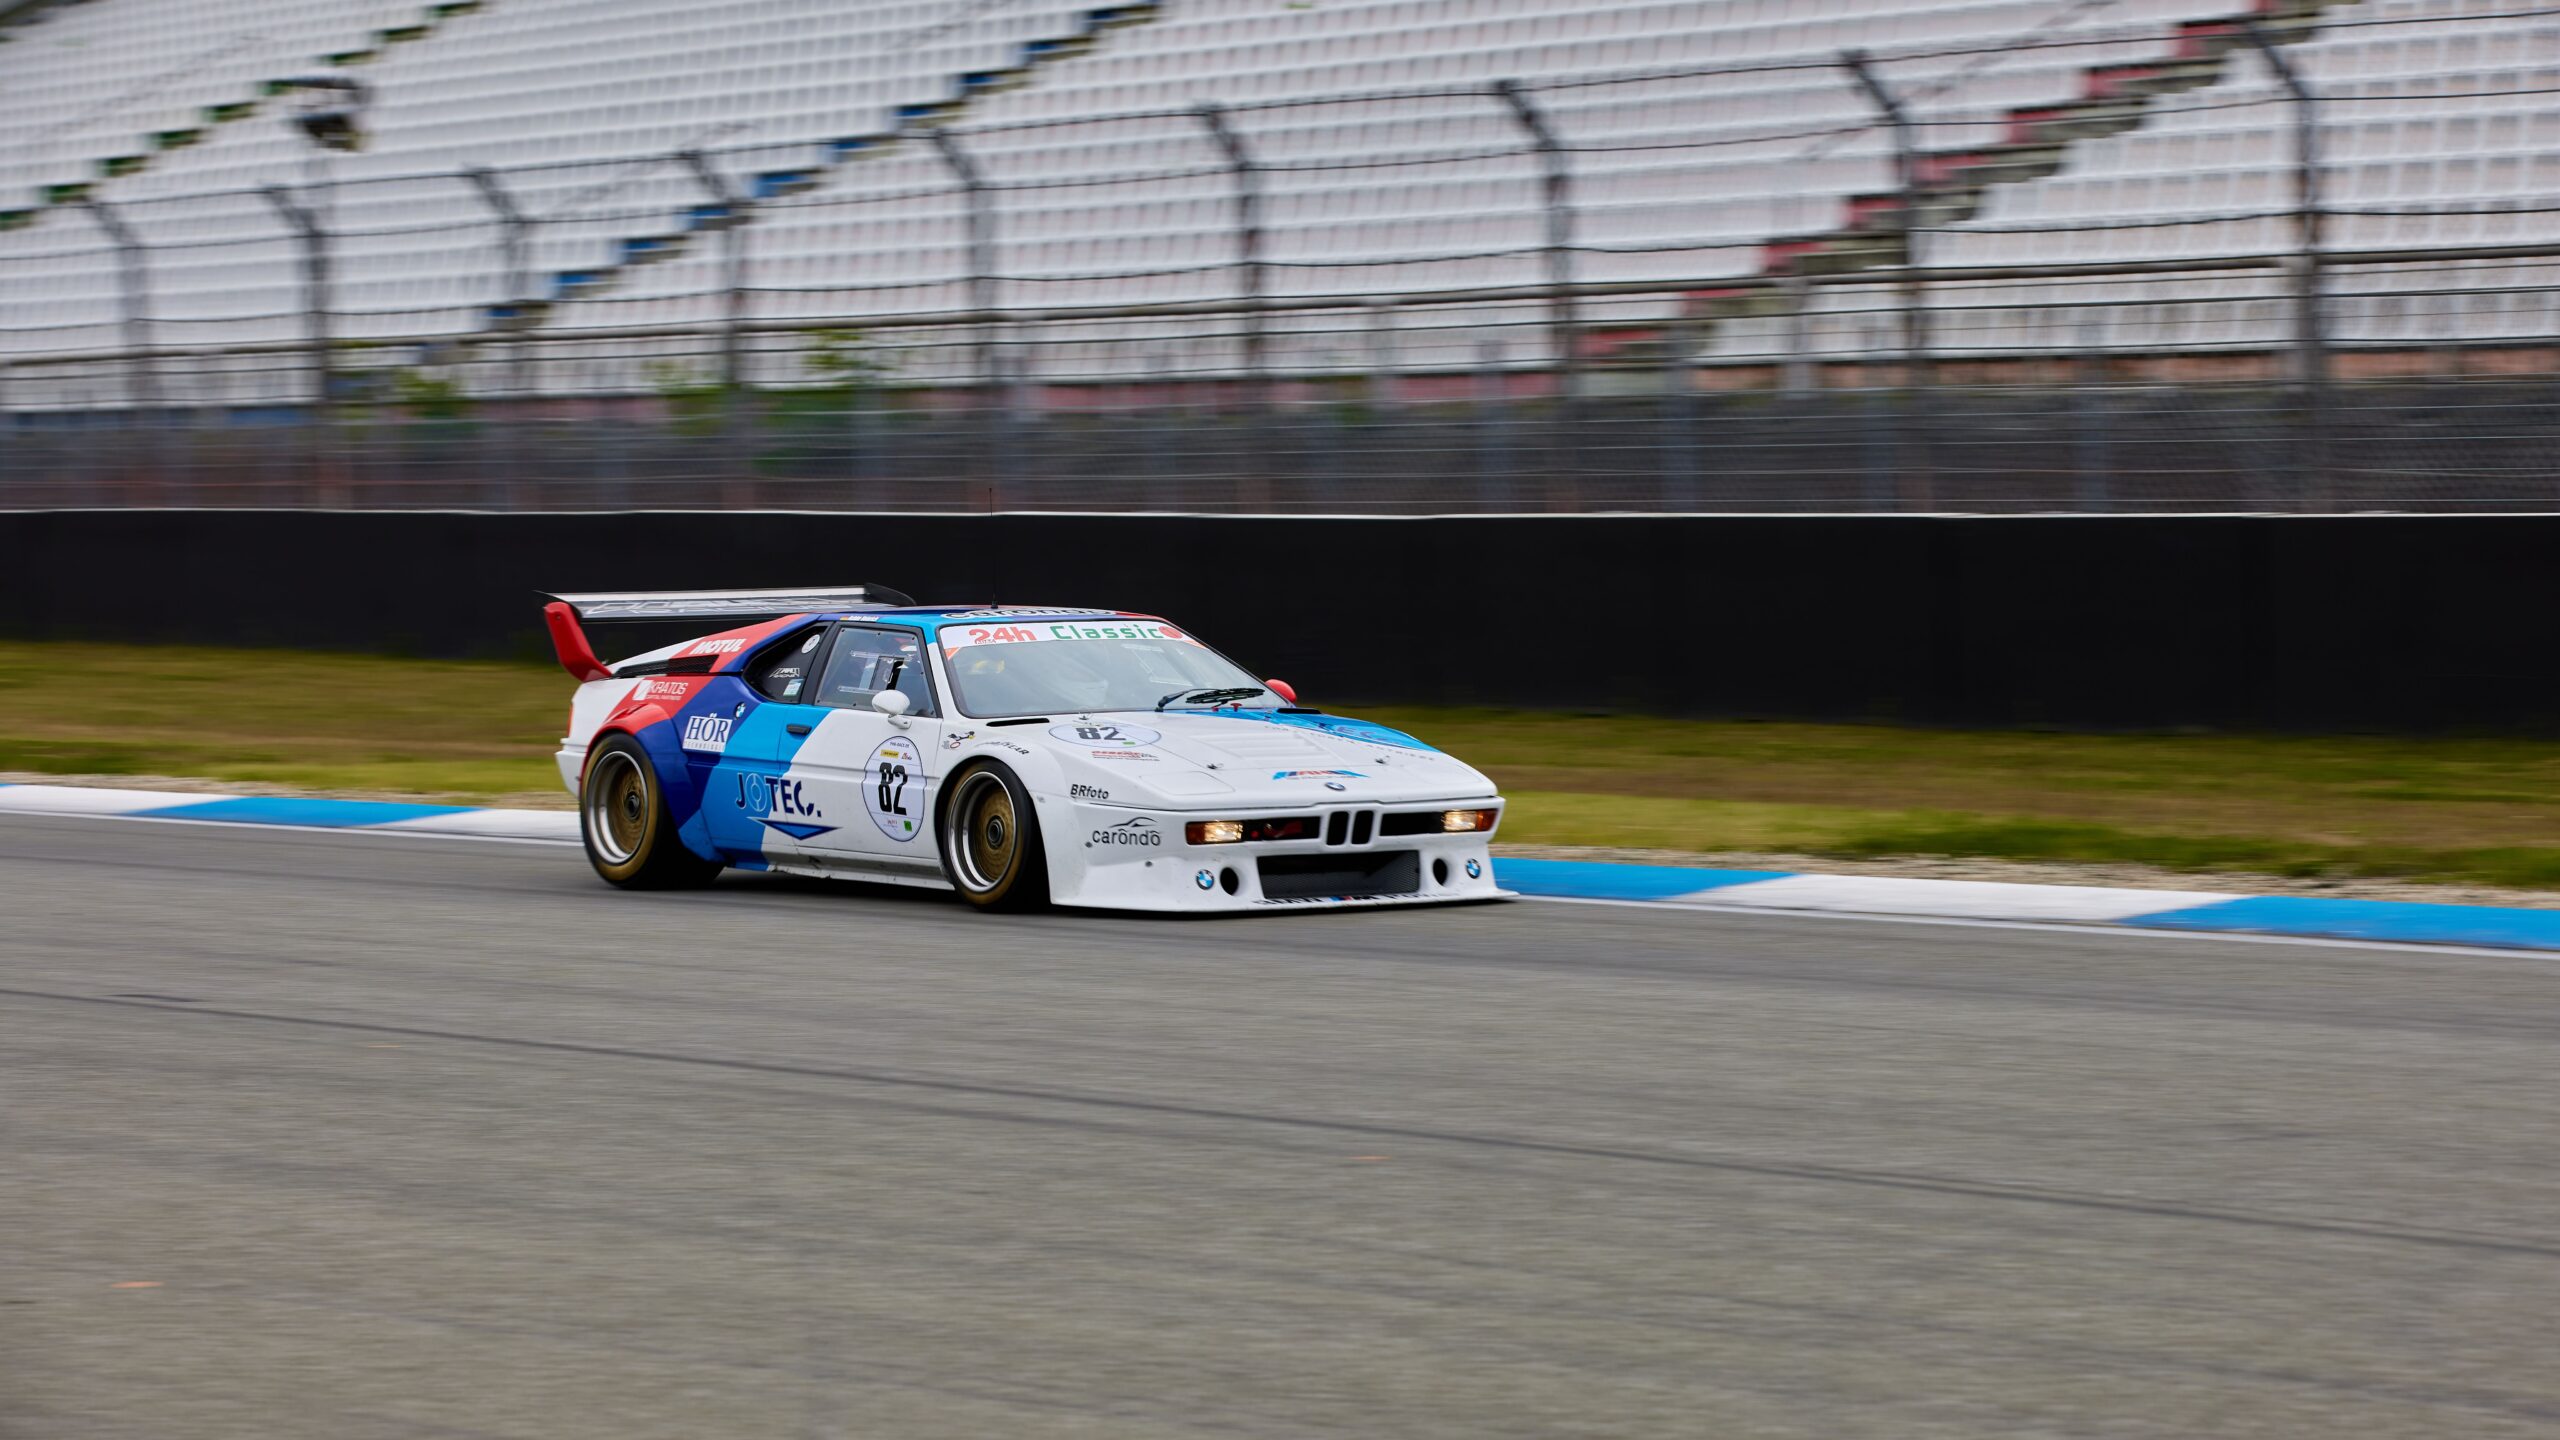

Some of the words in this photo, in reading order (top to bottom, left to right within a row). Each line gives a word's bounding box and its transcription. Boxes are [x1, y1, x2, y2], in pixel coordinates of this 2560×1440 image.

[968, 626, 1036, 645] 24h
[1050, 624, 1163, 641] Classic
[689, 638, 747, 655] MOTUL
[651, 681, 688, 695] KRATOS
[686, 713, 728, 743] HÖR
[1075, 726, 1127, 742] 82
[878, 762, 908, 816] 82
[1070, 784, 1109, 799] BRfoto
